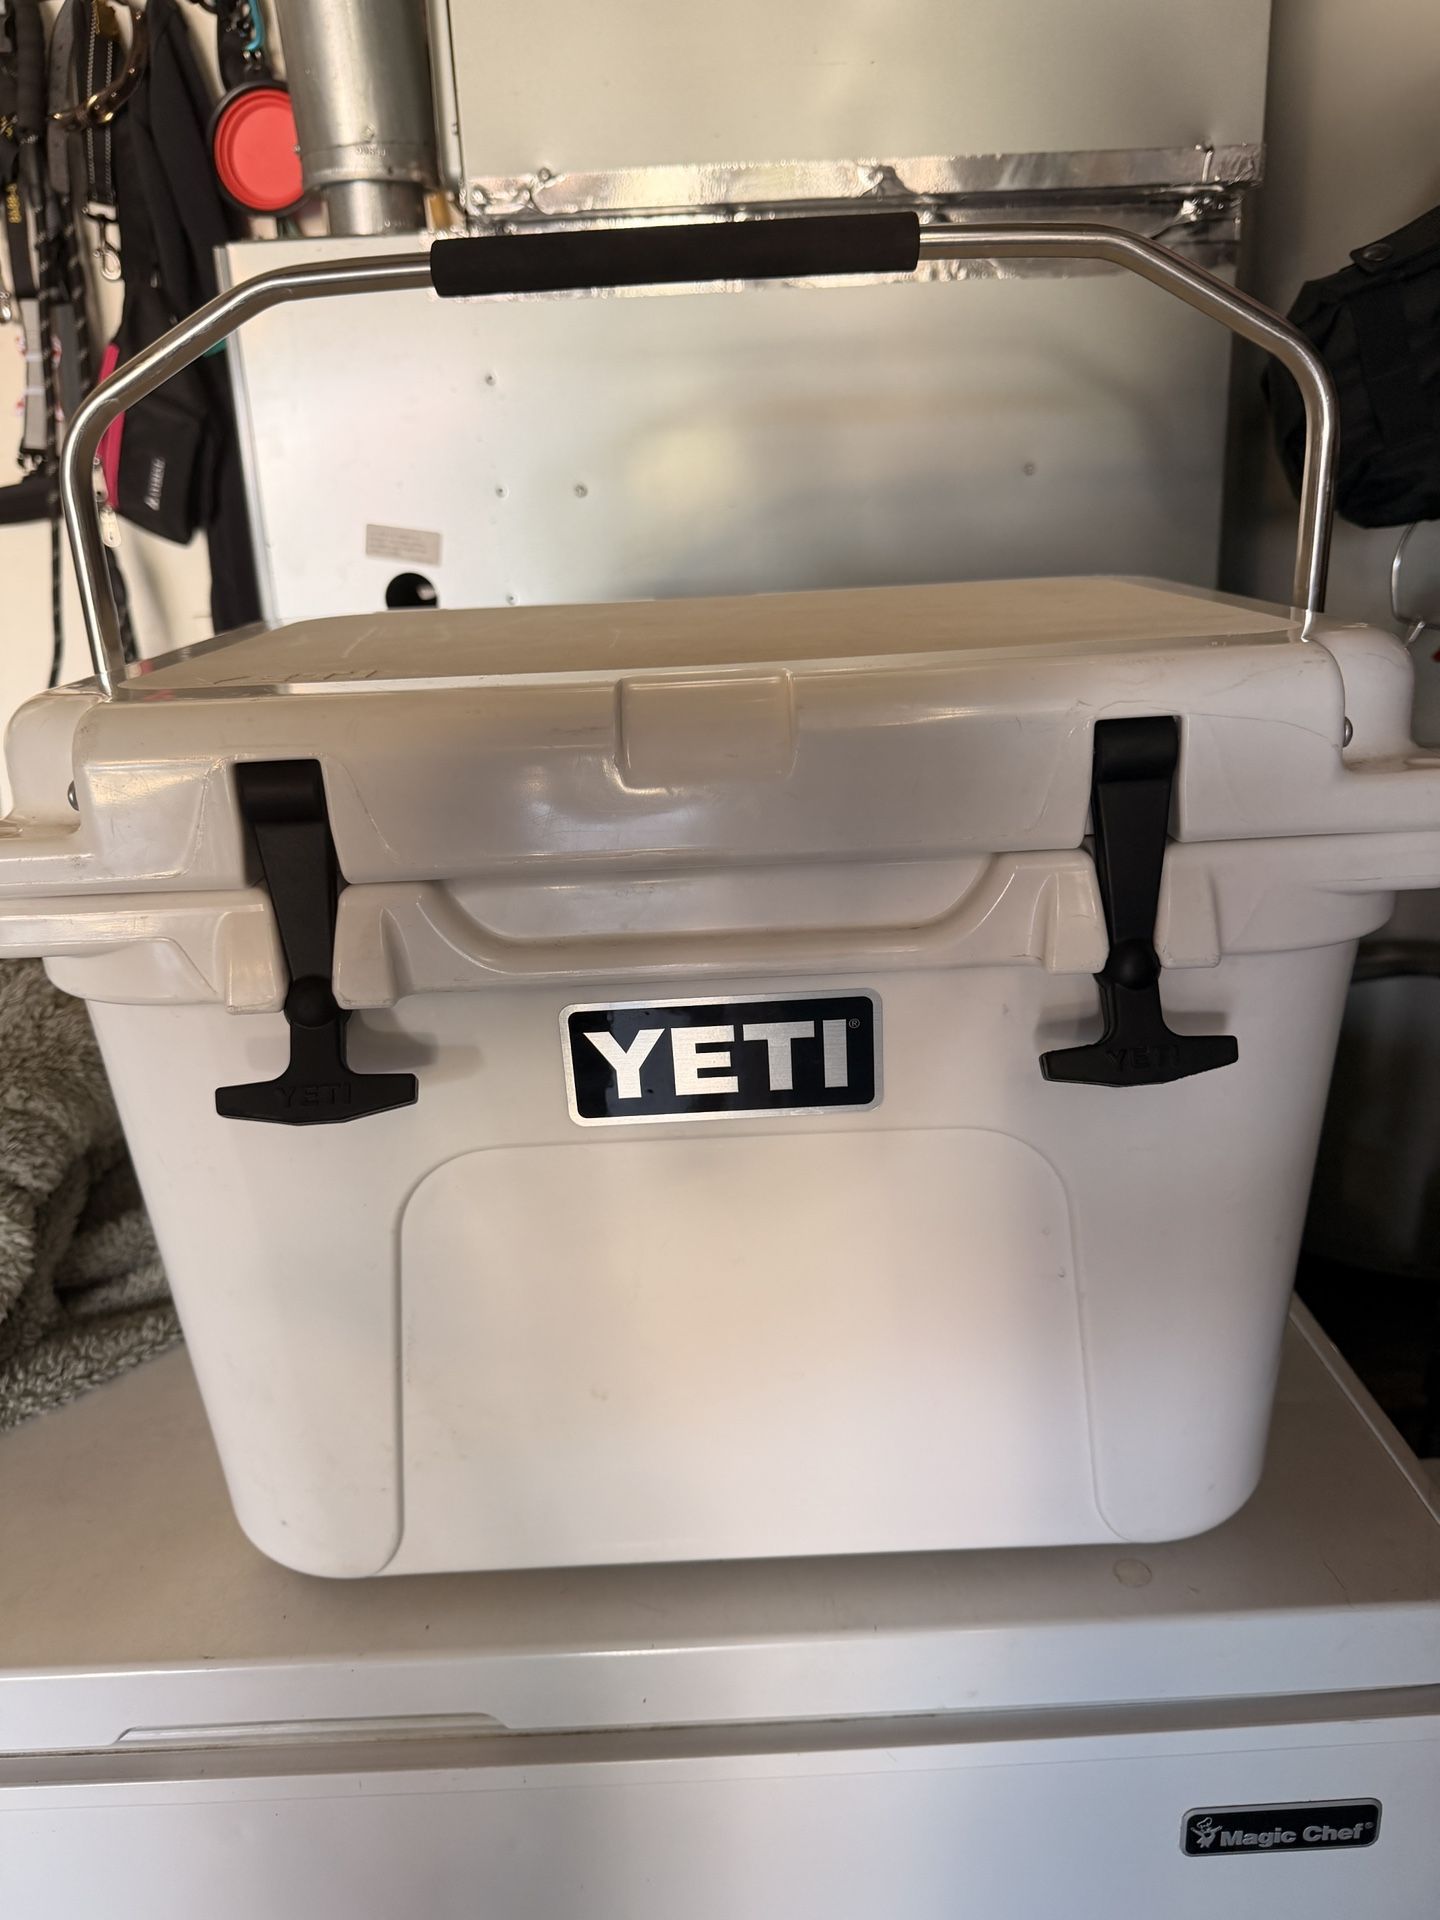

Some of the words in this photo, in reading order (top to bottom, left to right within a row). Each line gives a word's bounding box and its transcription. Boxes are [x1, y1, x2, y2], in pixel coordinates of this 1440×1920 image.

[1106, 1044, 1181, 1072] YETI
[274, 1082, 352, 1108] YETI
[1219, 1827, 1297, 1848] Magic
